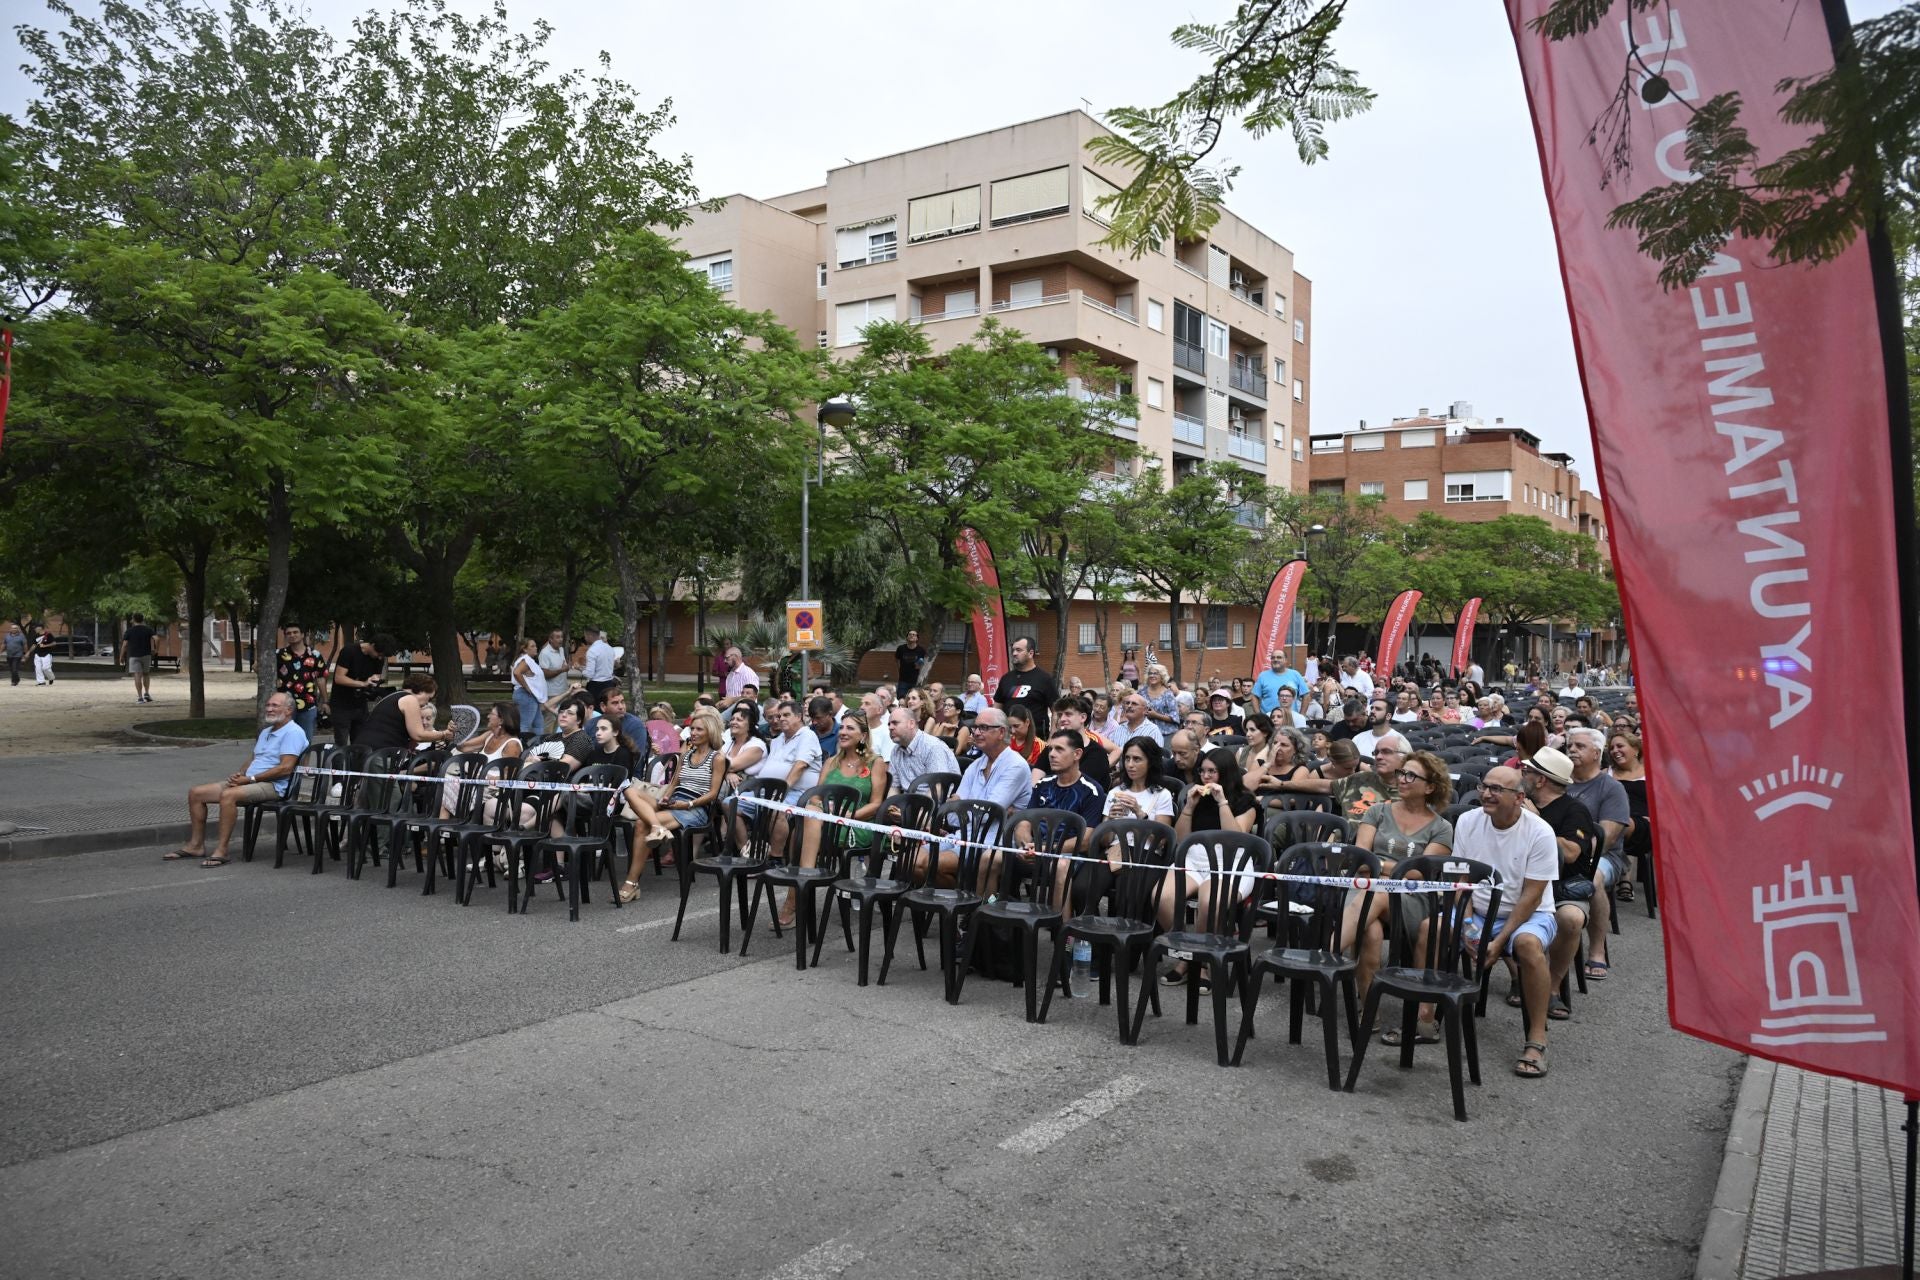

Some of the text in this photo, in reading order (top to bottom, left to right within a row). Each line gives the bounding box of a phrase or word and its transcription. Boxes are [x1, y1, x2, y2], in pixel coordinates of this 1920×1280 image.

[1265, 562, 1296, 661] AYUNTAMIENTO DE MURCIA
[1399, 590, 1414, 613] MURCIA
